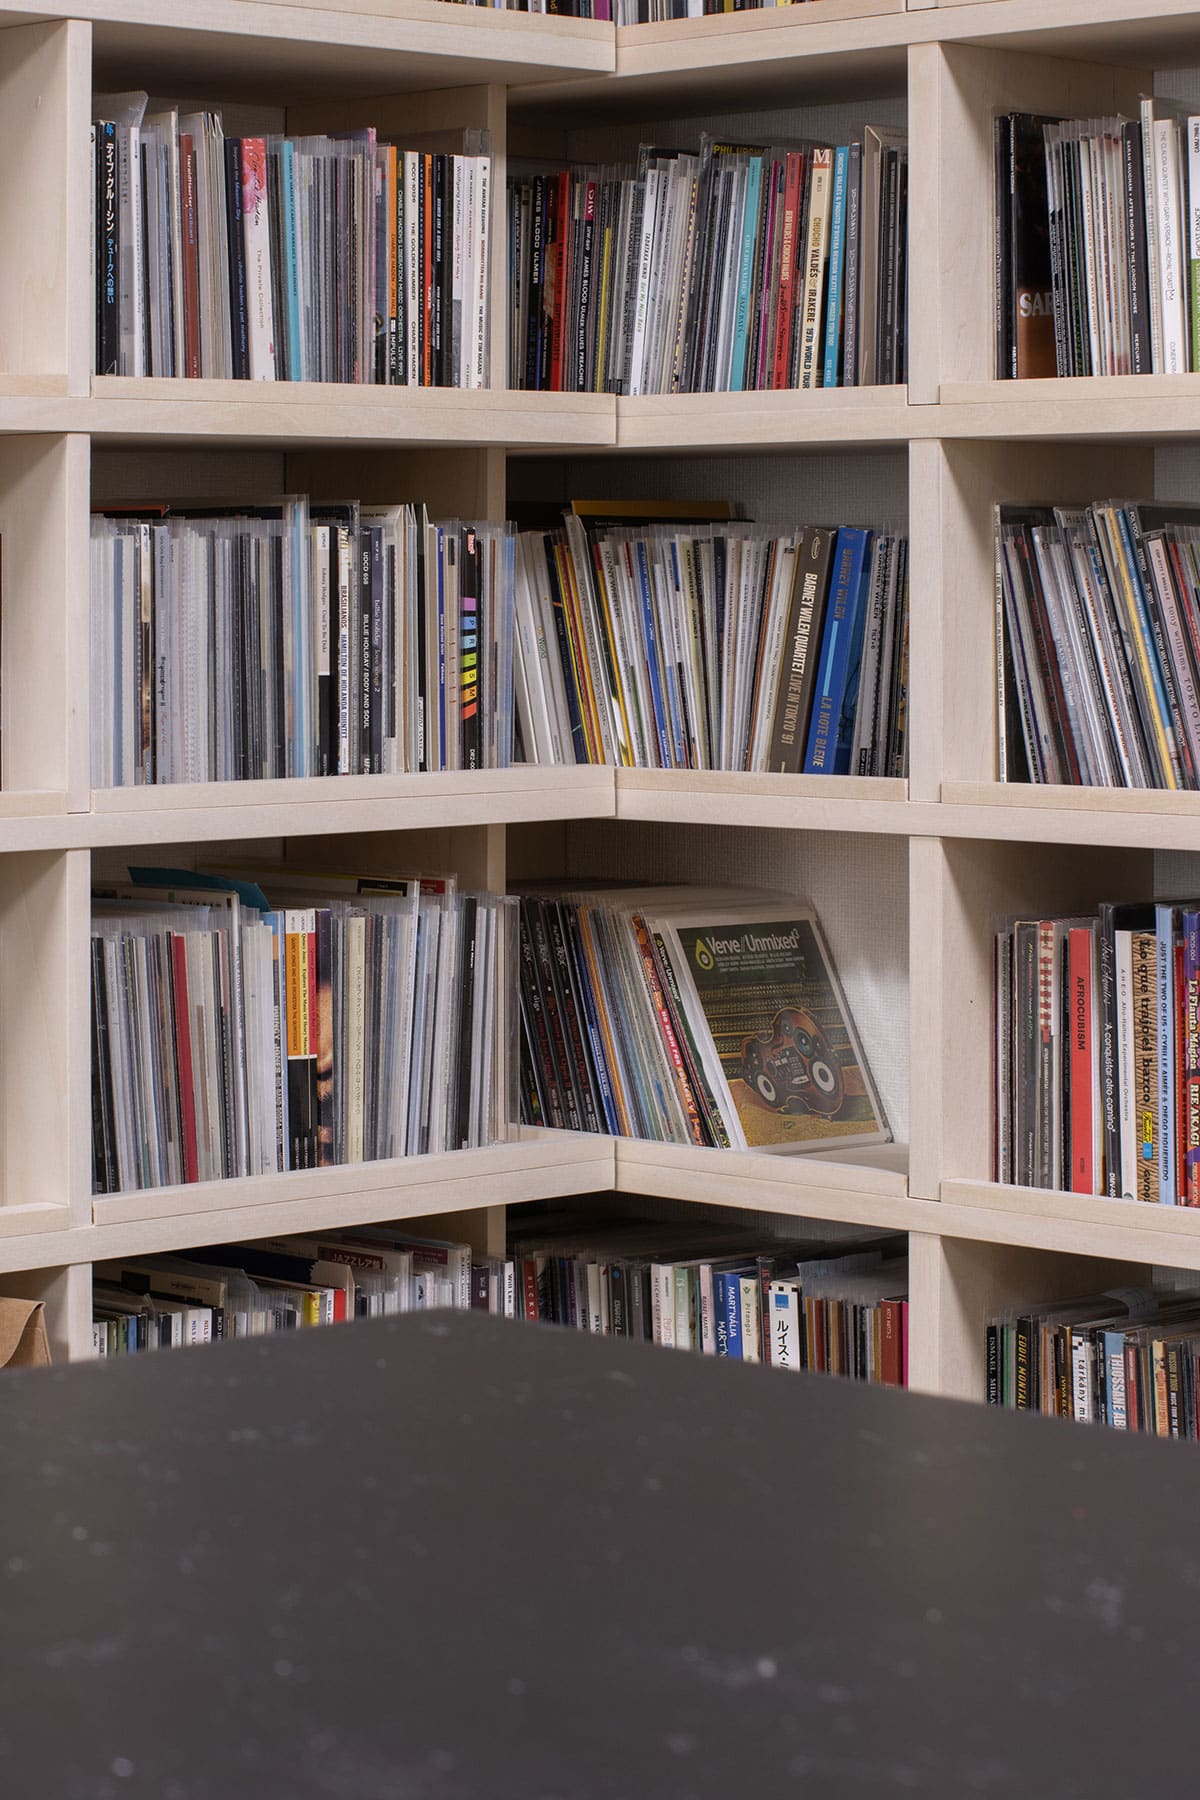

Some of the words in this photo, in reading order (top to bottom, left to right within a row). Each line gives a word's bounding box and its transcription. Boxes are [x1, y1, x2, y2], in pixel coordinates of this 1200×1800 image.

[812, 217, 822, 247] CHUCHO
[810, 249, 821, 278] VALDÉS
[638, 293, 646, 302] My
[807, 289, 817, 322] IRAKERE
[806, 328, 814, 342] 1978
[804, 346, 813, 369] WORLD
[802, 372, 812, 389] TOUR
[1130, 511, 1140, 539] POLYDOR
[604, 551, 615, 578] KENNY
[839, 548, 853, 585] BARNEY
[1138, 549, 1148, 572] STEREO
[608, 579, 622, 619] WHEELER
[801, 573, 818, 607] BARNEY
[834, 589, 848, 619] WILEN
[373, 618, 381, 645] holiday
[797, 608, 814, 635] WILEN
[791, 635, 810, 674] QUARTET
[1156, 634, 1164, 650] TONY
[1159, 651, 1171, 680] WILLIAMS
[1167, 606, 1178, 627] tony
[1173, 631, 1186, 671] williams
[1184, 678, 1198, 719] TOKYO
[789, 674, 805, 693] LIVE
[1166, 680, 1177, 705] LIFETIME
[784, 703, 800, 730] TOKYO
[820, 697, 833, 709] LA
[817, 711, 831, 736] NOTE
[782, 732, 797, 744] '91
[813, 738, 828, 768] BLEUE
[1139, 941, 1152, 959] Lo
[1138, 965, 1150, 992] que
[1189, 981, 1197, 994] La
[1076, 976, 1086, 1050] AFROCUBISM
[1139, 998, 1152, 1034] trajo
[1161, 1002, 1167, 1014] OF
[1161, 1015, 1168, 1027] US
[1189, 995, 1197, 1030] Flauta
[672, 1049, 680, 1065] FOR
[1104, 1033, 1113, 1076] conquistar
[1142, 1038, 1152, 1052] el
[1188, 1033, 1198, 1070] Mágica
[1142, 1058, 1153, 1102] barco
[1190, 1084, 1199, 1105] RIE
[1190, 1106, 1199, 1146] AKAGI
[1018, 1334, 1027, 1365] EDDIE
[1110, 1354, 1126, 1411] THIOSSANE
